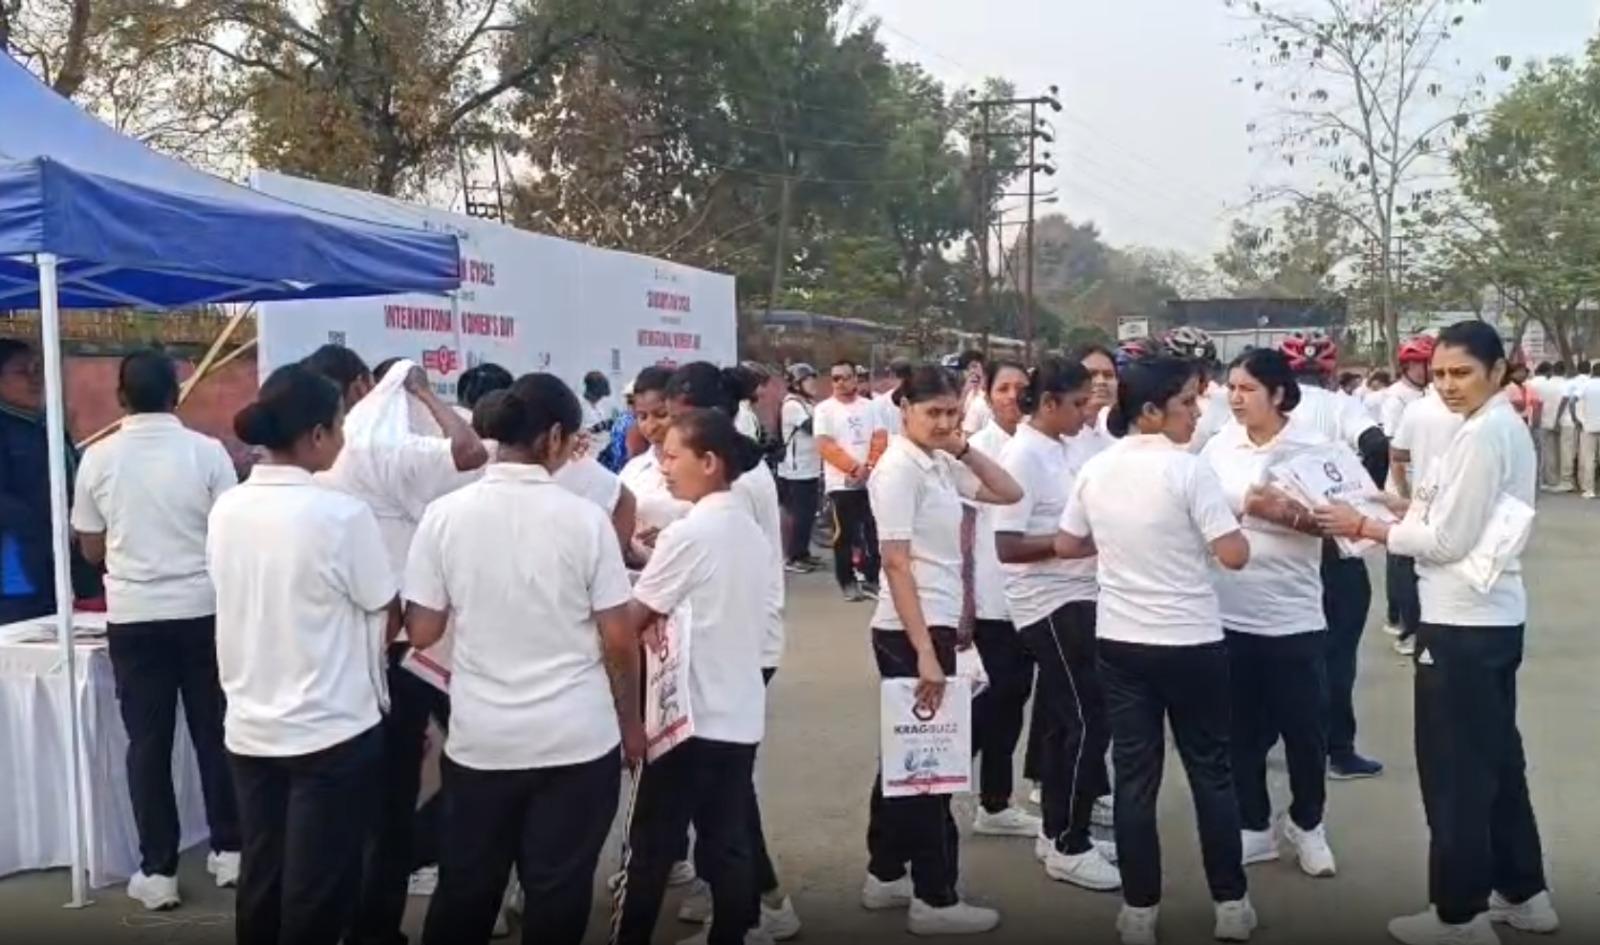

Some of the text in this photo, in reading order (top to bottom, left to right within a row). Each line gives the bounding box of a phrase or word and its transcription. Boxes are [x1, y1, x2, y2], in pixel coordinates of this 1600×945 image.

[469, 259, 495, 286] CYCLE
[384, 304, 452, 332] INTERNATIONA
[894, 723, 958, 735] KRAGBUZZ
